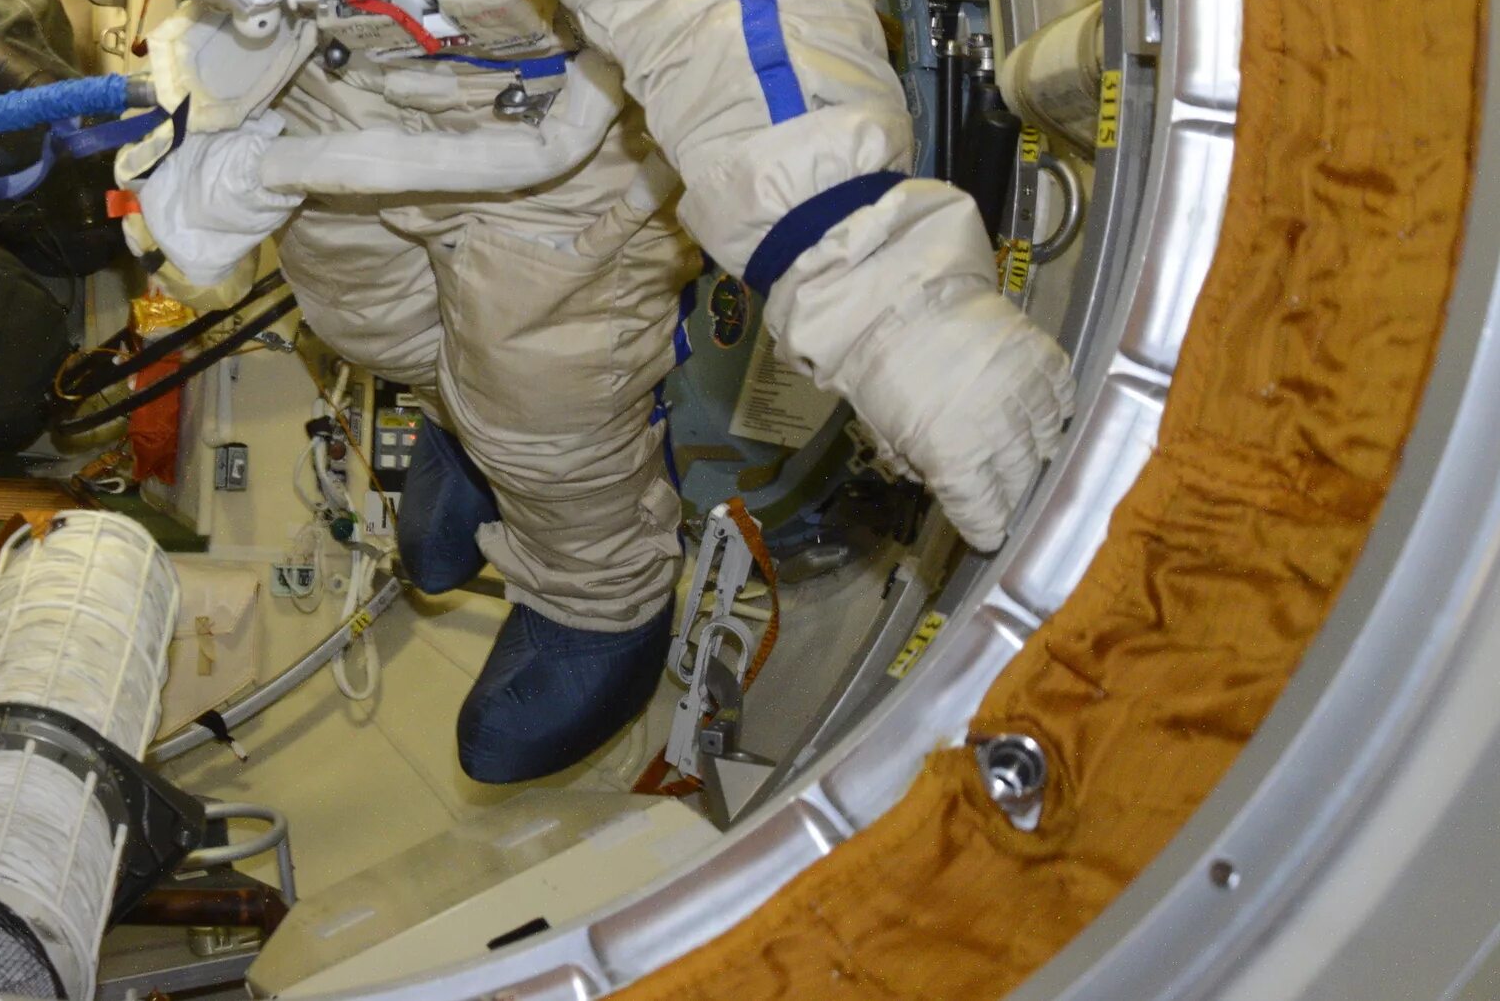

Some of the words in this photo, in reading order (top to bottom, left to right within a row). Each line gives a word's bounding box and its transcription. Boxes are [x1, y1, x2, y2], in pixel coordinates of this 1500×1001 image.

[1100, 75, 1118, 143] 3115
[1021, 125, 1041, 160] 310
[1008, 246, 1030, 290] 3107
